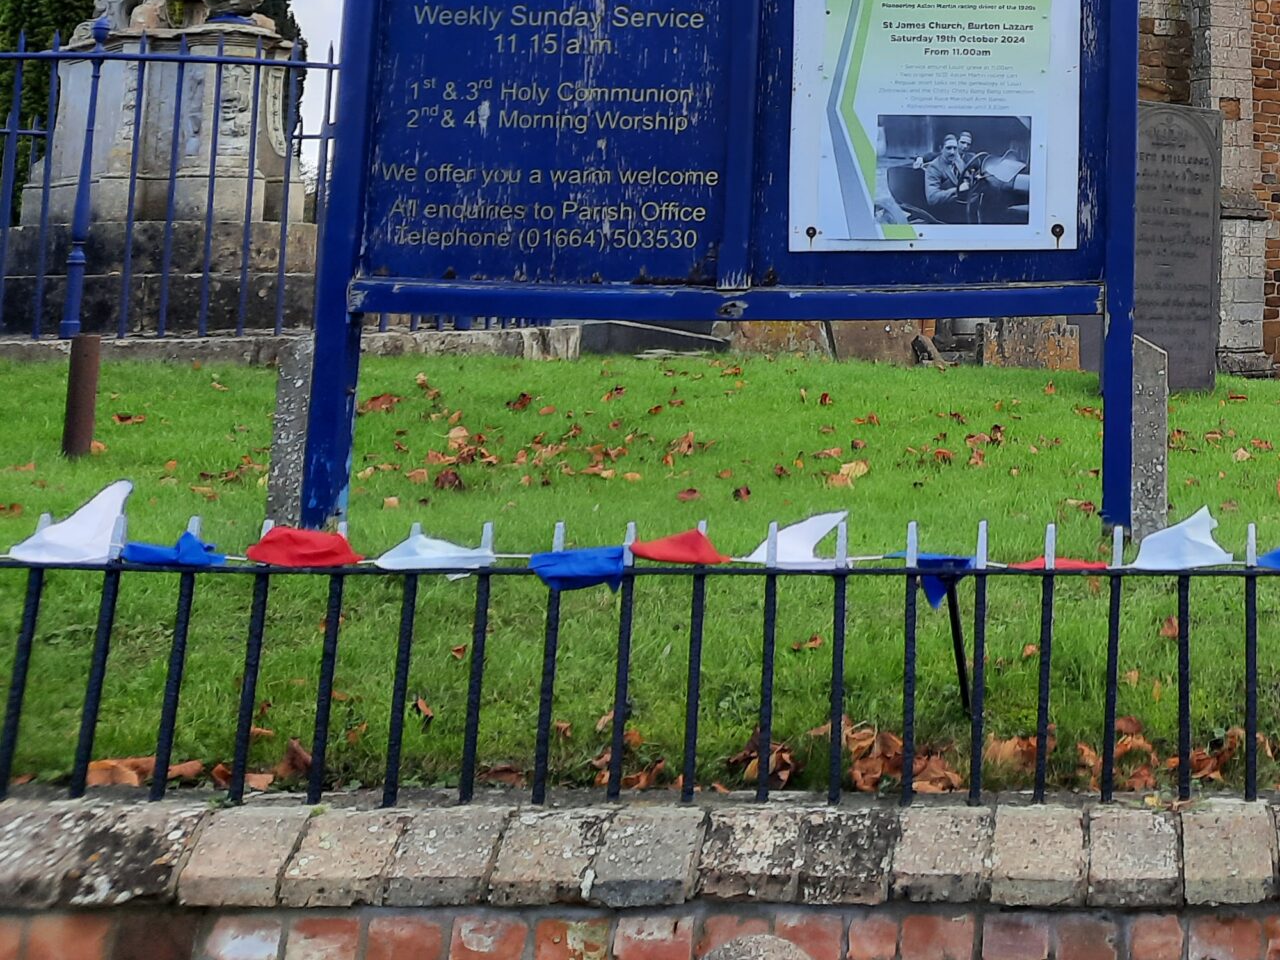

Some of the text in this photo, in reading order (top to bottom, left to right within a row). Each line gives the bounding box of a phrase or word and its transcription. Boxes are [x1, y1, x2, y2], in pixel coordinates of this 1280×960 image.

[413, 4, 705, 32] Weekly Sunday Service
[882, 21, 893, 29] St
[928, 22, 966, 30] Church,
[967, 22, 1000, 30] Burton
[1003, 23, 1034, 31] Lazars
[494, 33, 558, 54] 11.15
[890, 34, 1026, 44] Saturday 19th October 2024
[924, 47, 991, 56] From 11.00am
[442, 81, 458, 100] &
[500, 82, 550, 106] Holy
[557, 82, 693, 104] Communion
[440, 109, 456, 128] &
[498, 110, 588, 134] Morning
[595, 111, 689, 134] Worship
[382, 163, 720, 188] We offer you a warm welcome
[388, 198, 707, 223] All enquiries to Parish Office
[395, 223, 698, 253] Telephone (01664) 503530
